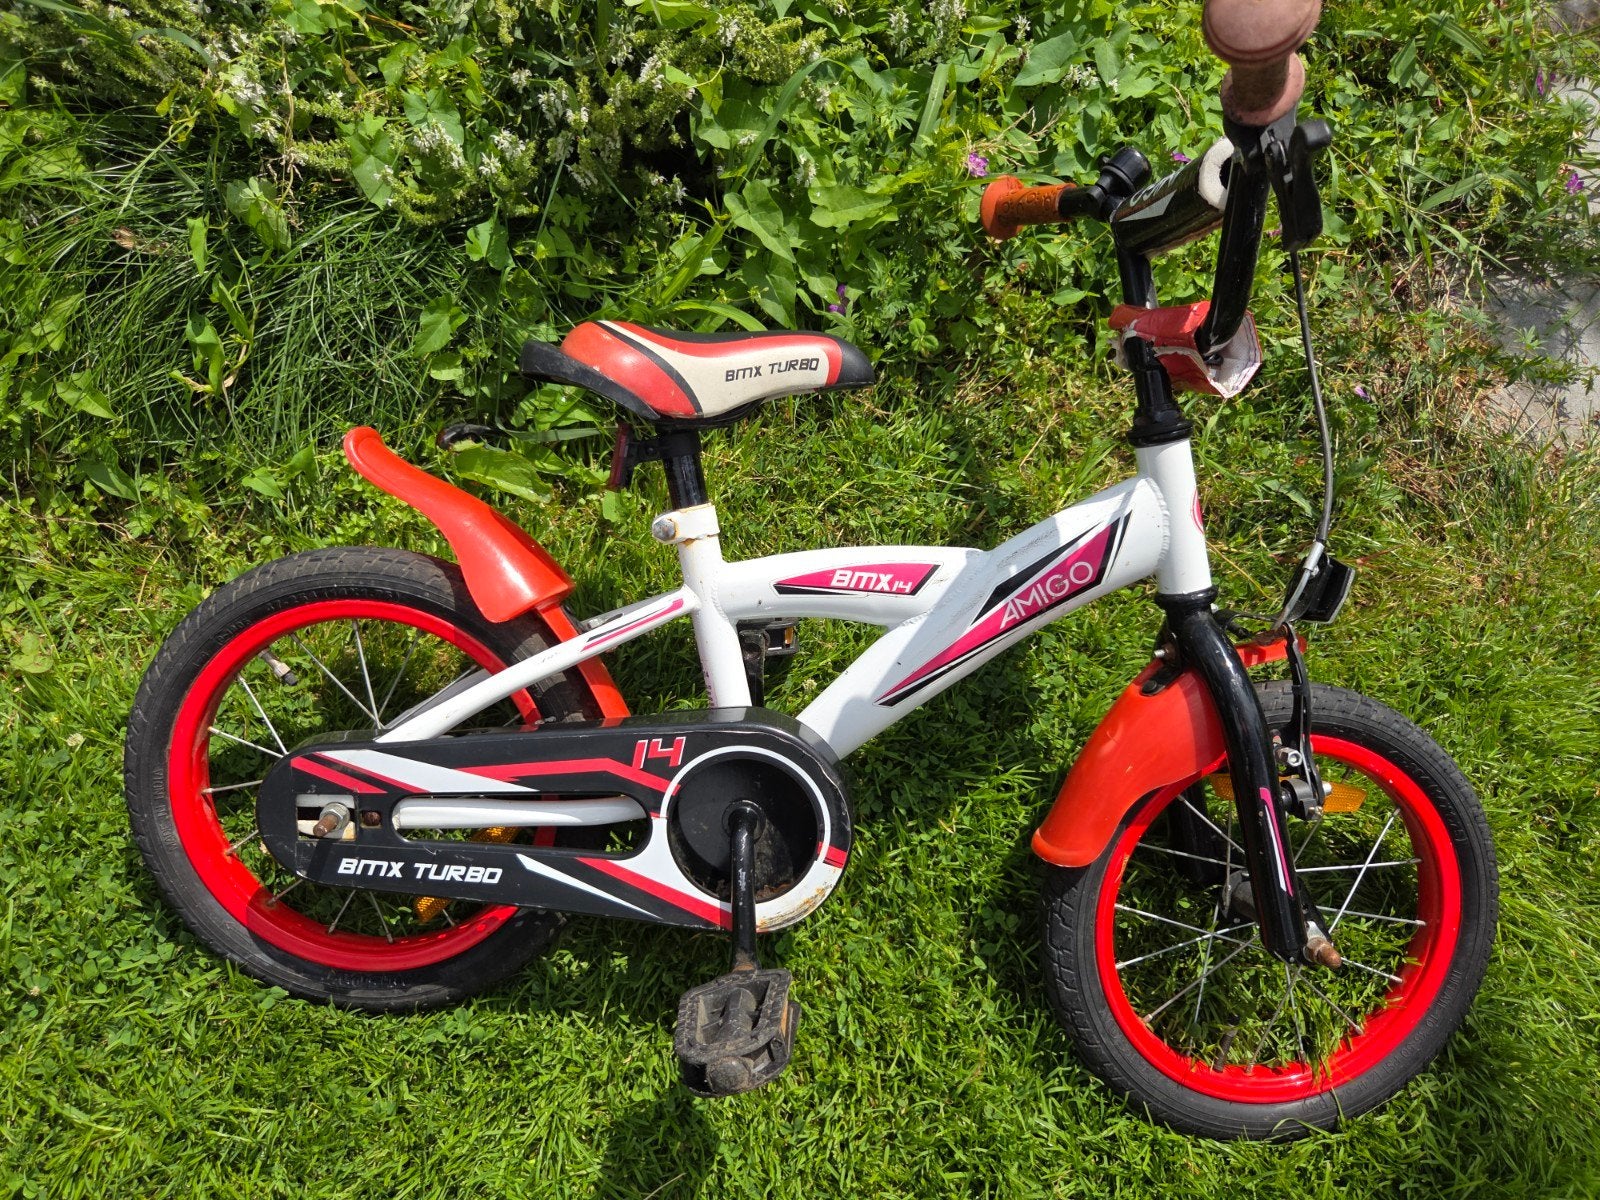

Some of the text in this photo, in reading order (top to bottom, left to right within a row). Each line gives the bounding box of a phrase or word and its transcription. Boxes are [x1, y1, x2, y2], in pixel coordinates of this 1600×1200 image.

[725, 358, 819, 382] BMX TURBO
[1000, 562, 1093, 629] AMIGO
[631, 737, 686, 769] 14
[337, 858, 503, 884] BMX TURBO
